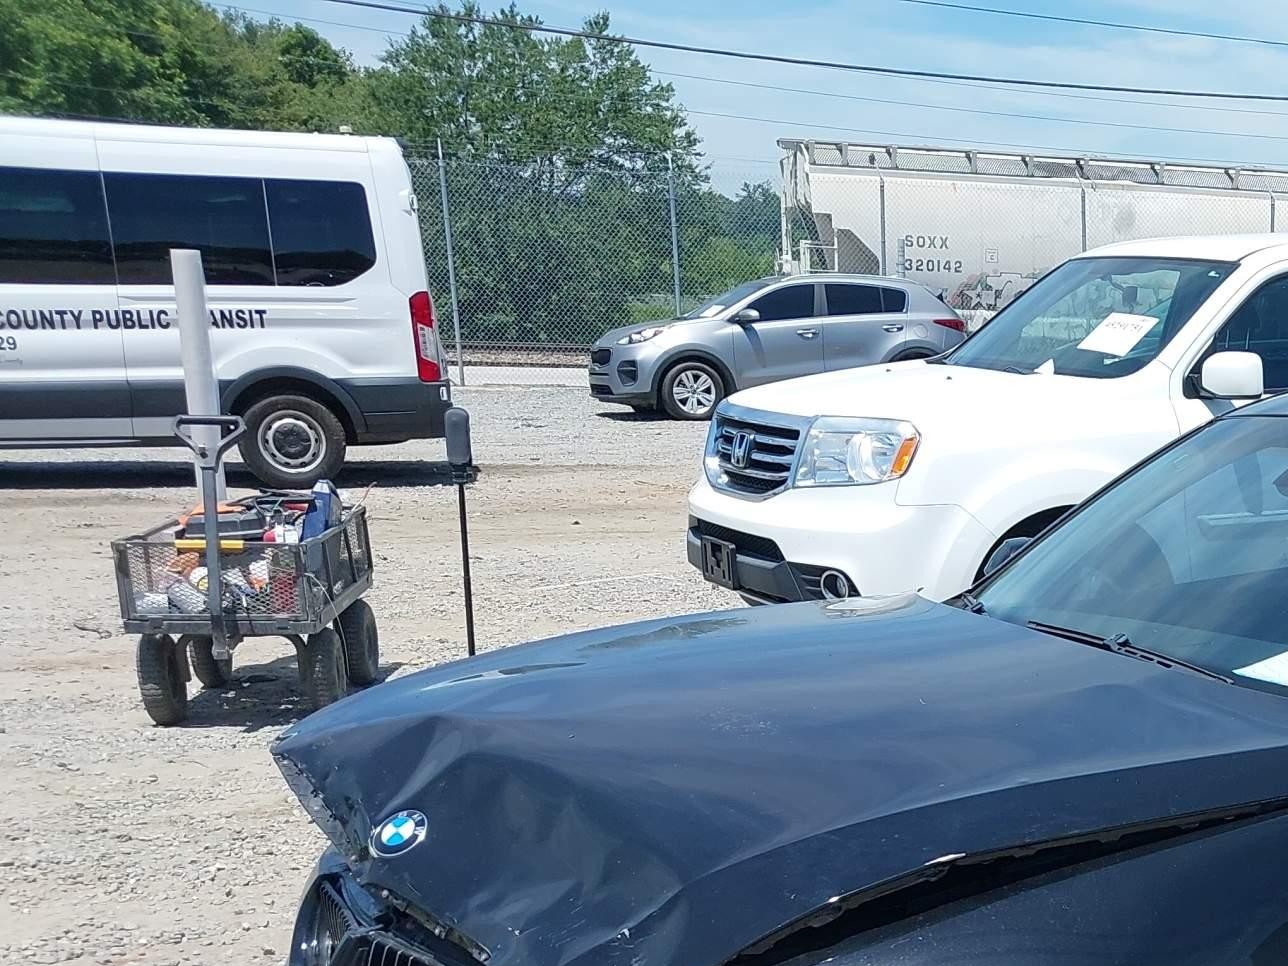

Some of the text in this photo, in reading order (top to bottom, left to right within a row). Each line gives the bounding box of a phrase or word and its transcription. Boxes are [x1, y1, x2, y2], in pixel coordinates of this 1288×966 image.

[905, 235, 948, 249] SOXX
[904, 258, 962, 273] 320142
[91, 309, 171, 330] PUBLIC
[176, 309, 267, 329] ANSIT
